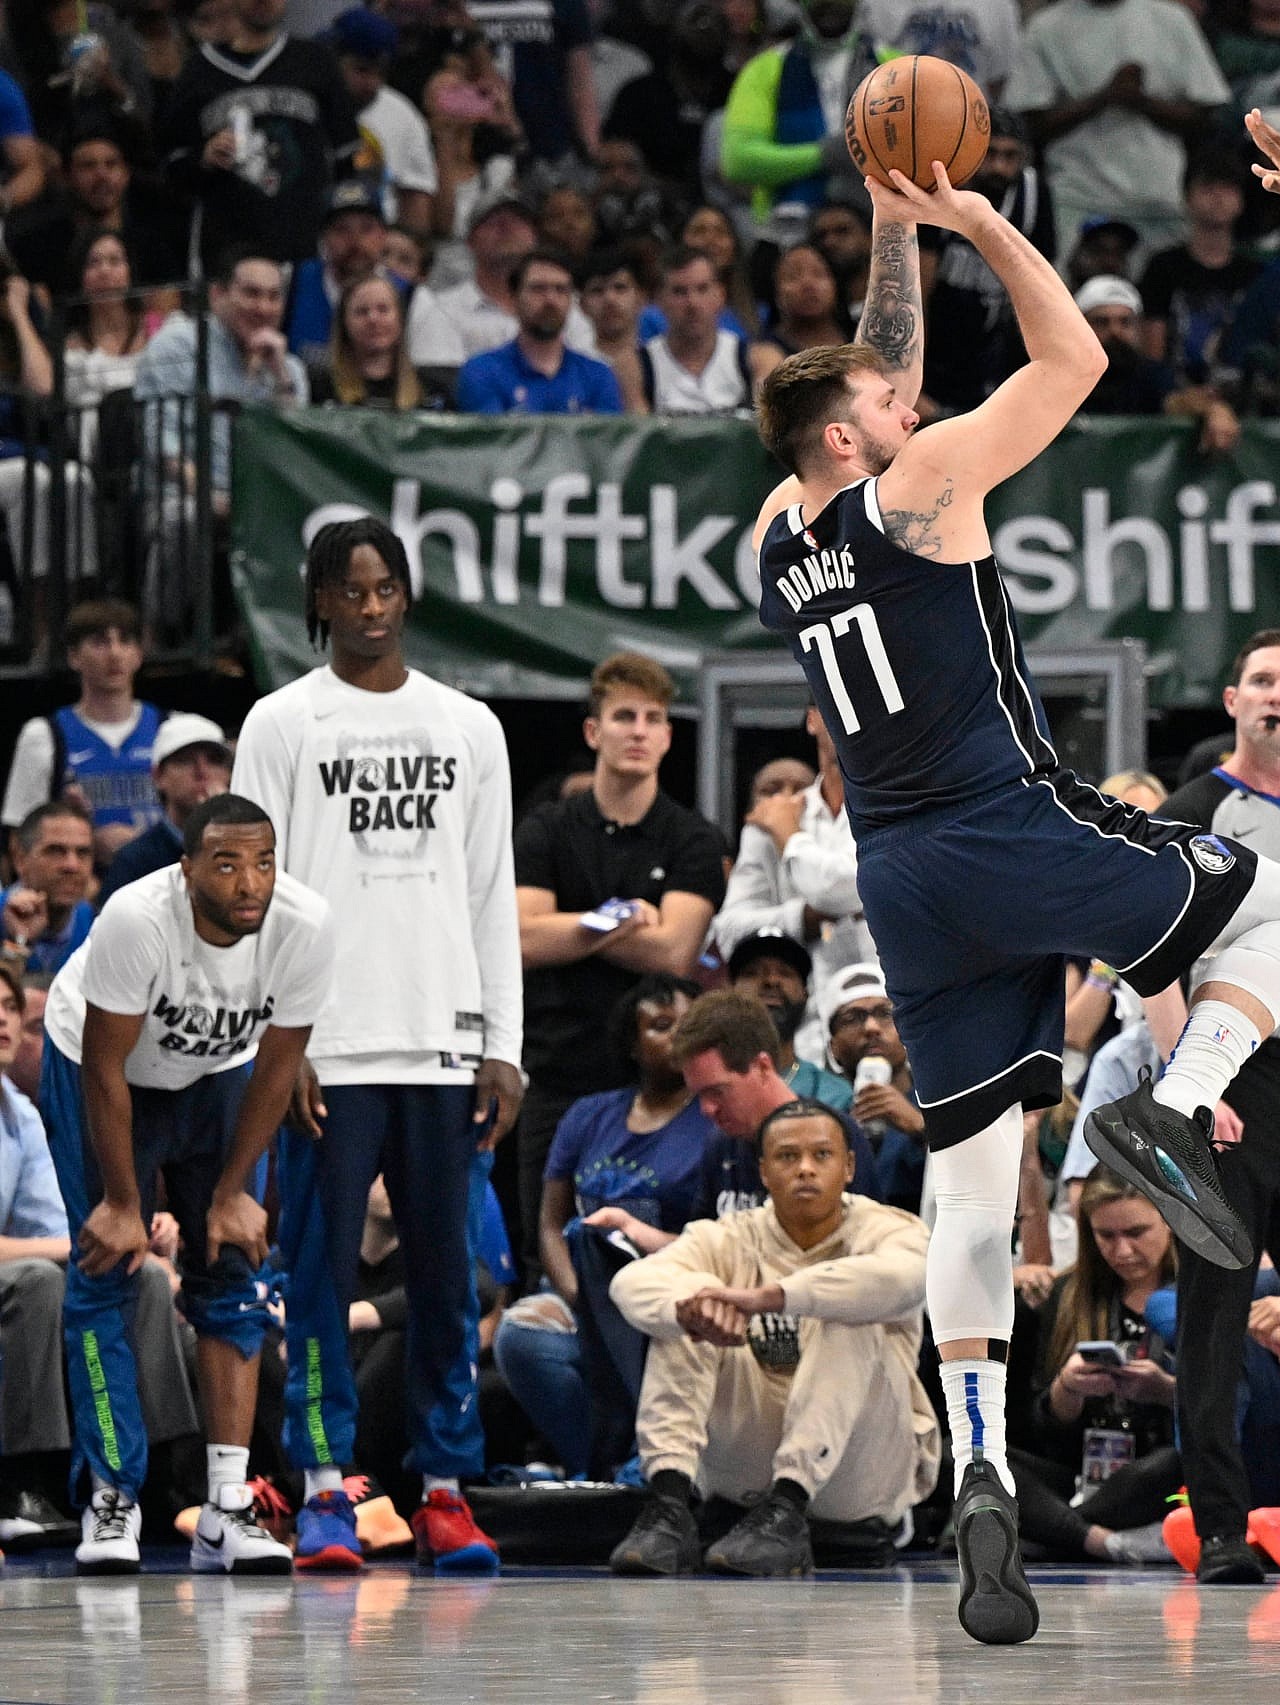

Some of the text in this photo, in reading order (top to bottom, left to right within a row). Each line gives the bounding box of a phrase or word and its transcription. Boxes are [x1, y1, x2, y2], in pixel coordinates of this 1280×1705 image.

[302, 473, 763, 610] hiftk
[799, 602, 905, 735] 77
[349, 794, 438, 833] BACK
